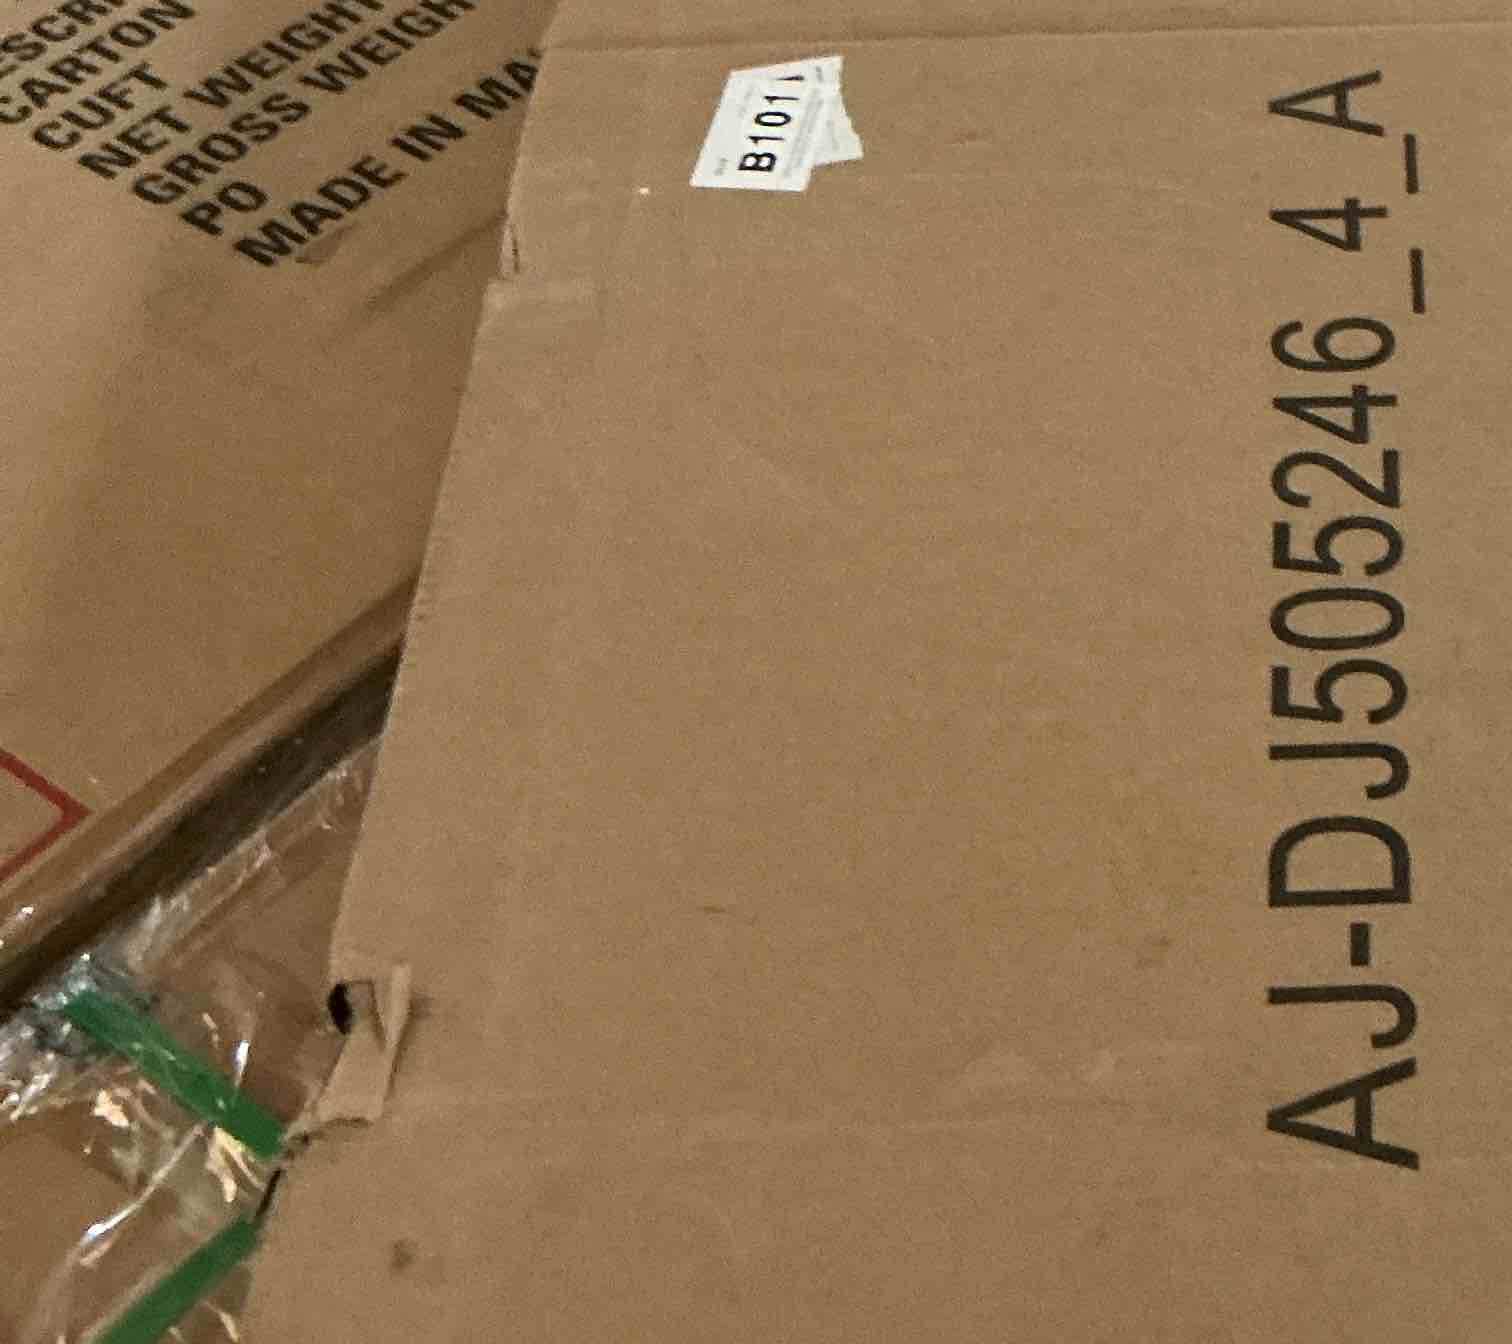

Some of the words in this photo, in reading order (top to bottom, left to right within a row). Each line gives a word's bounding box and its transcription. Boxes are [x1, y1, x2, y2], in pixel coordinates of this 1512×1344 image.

[33, 60, 168, 151] CUFT
[77, 103, 192, 181] NET
[131, 91, 313, 206] GROSS
[233, 154, 408, 268] MADE
[389, 111, 468, 163] IN
[453, 46, 544, 122] MA
[178, 181, 269, 238] PO
[1264, 68, 1426, 1172] AJ-DJ505246_4_A
